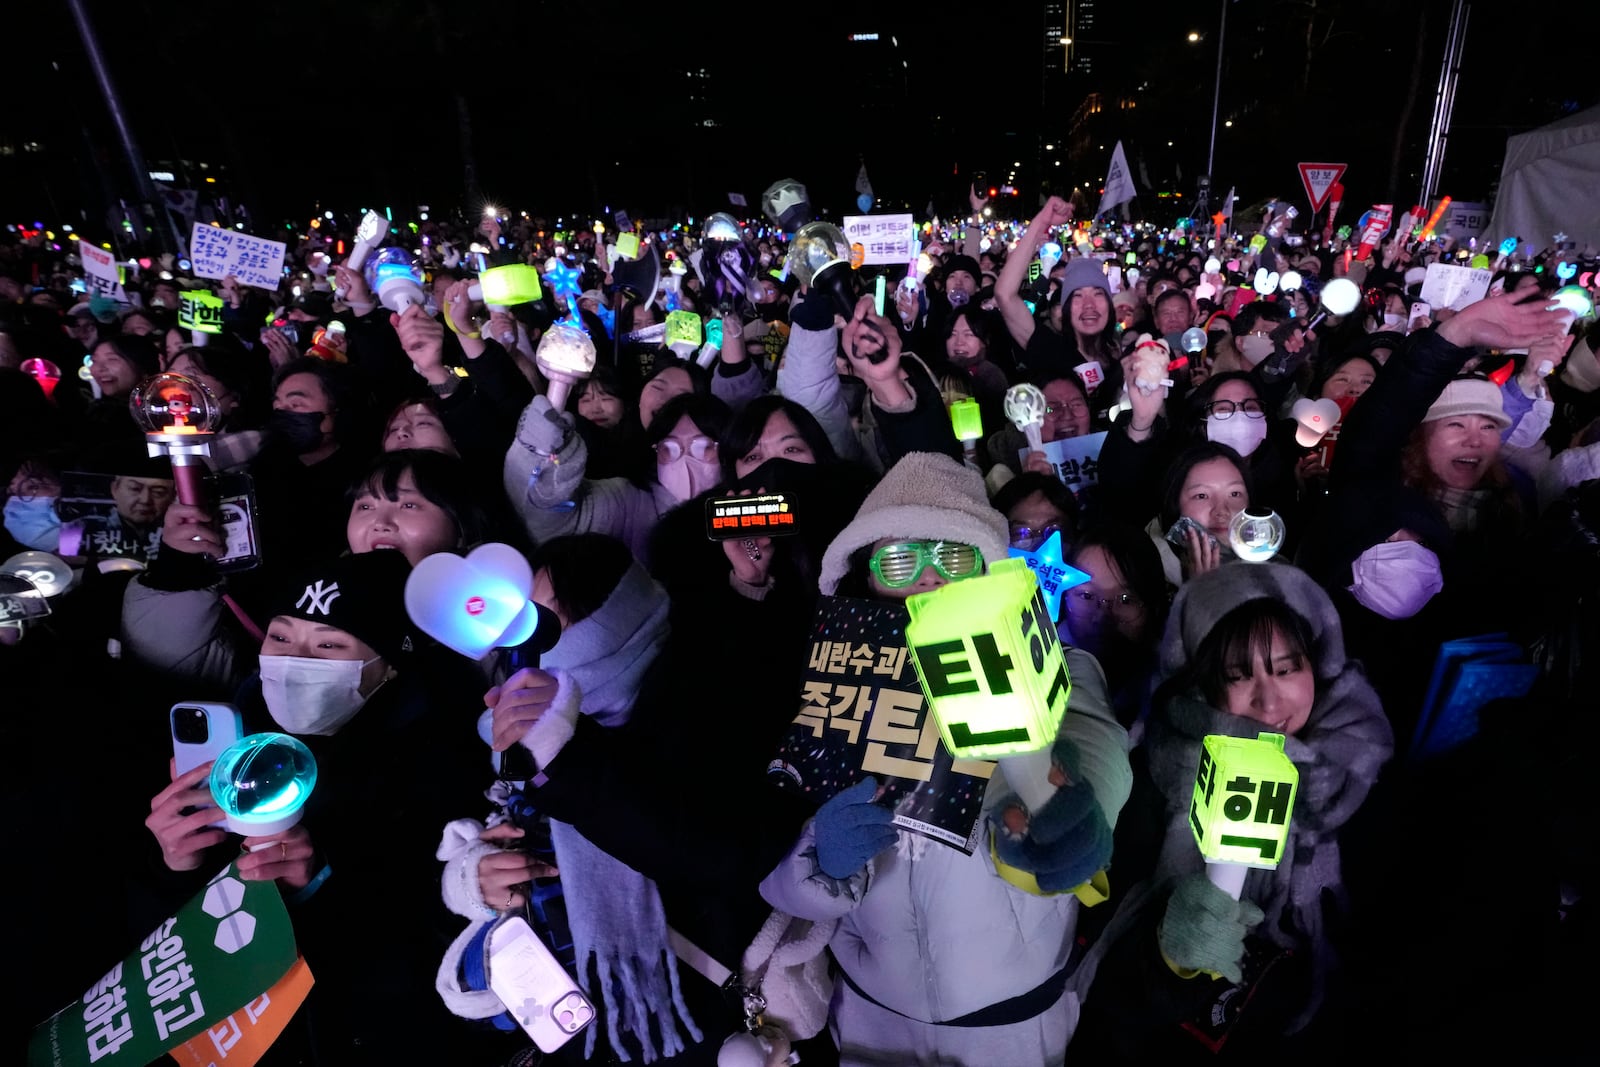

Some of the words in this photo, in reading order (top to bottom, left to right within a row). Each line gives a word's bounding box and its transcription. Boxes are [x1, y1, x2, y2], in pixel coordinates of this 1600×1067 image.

[194, 241, 228, 259] 고통과
[197, 226, 233, 245] 당신이
[295, 580, 341, 615] NY
[809, 641, 908, 681] 내란수괴
[791, 681, 873, 745] 즉각
